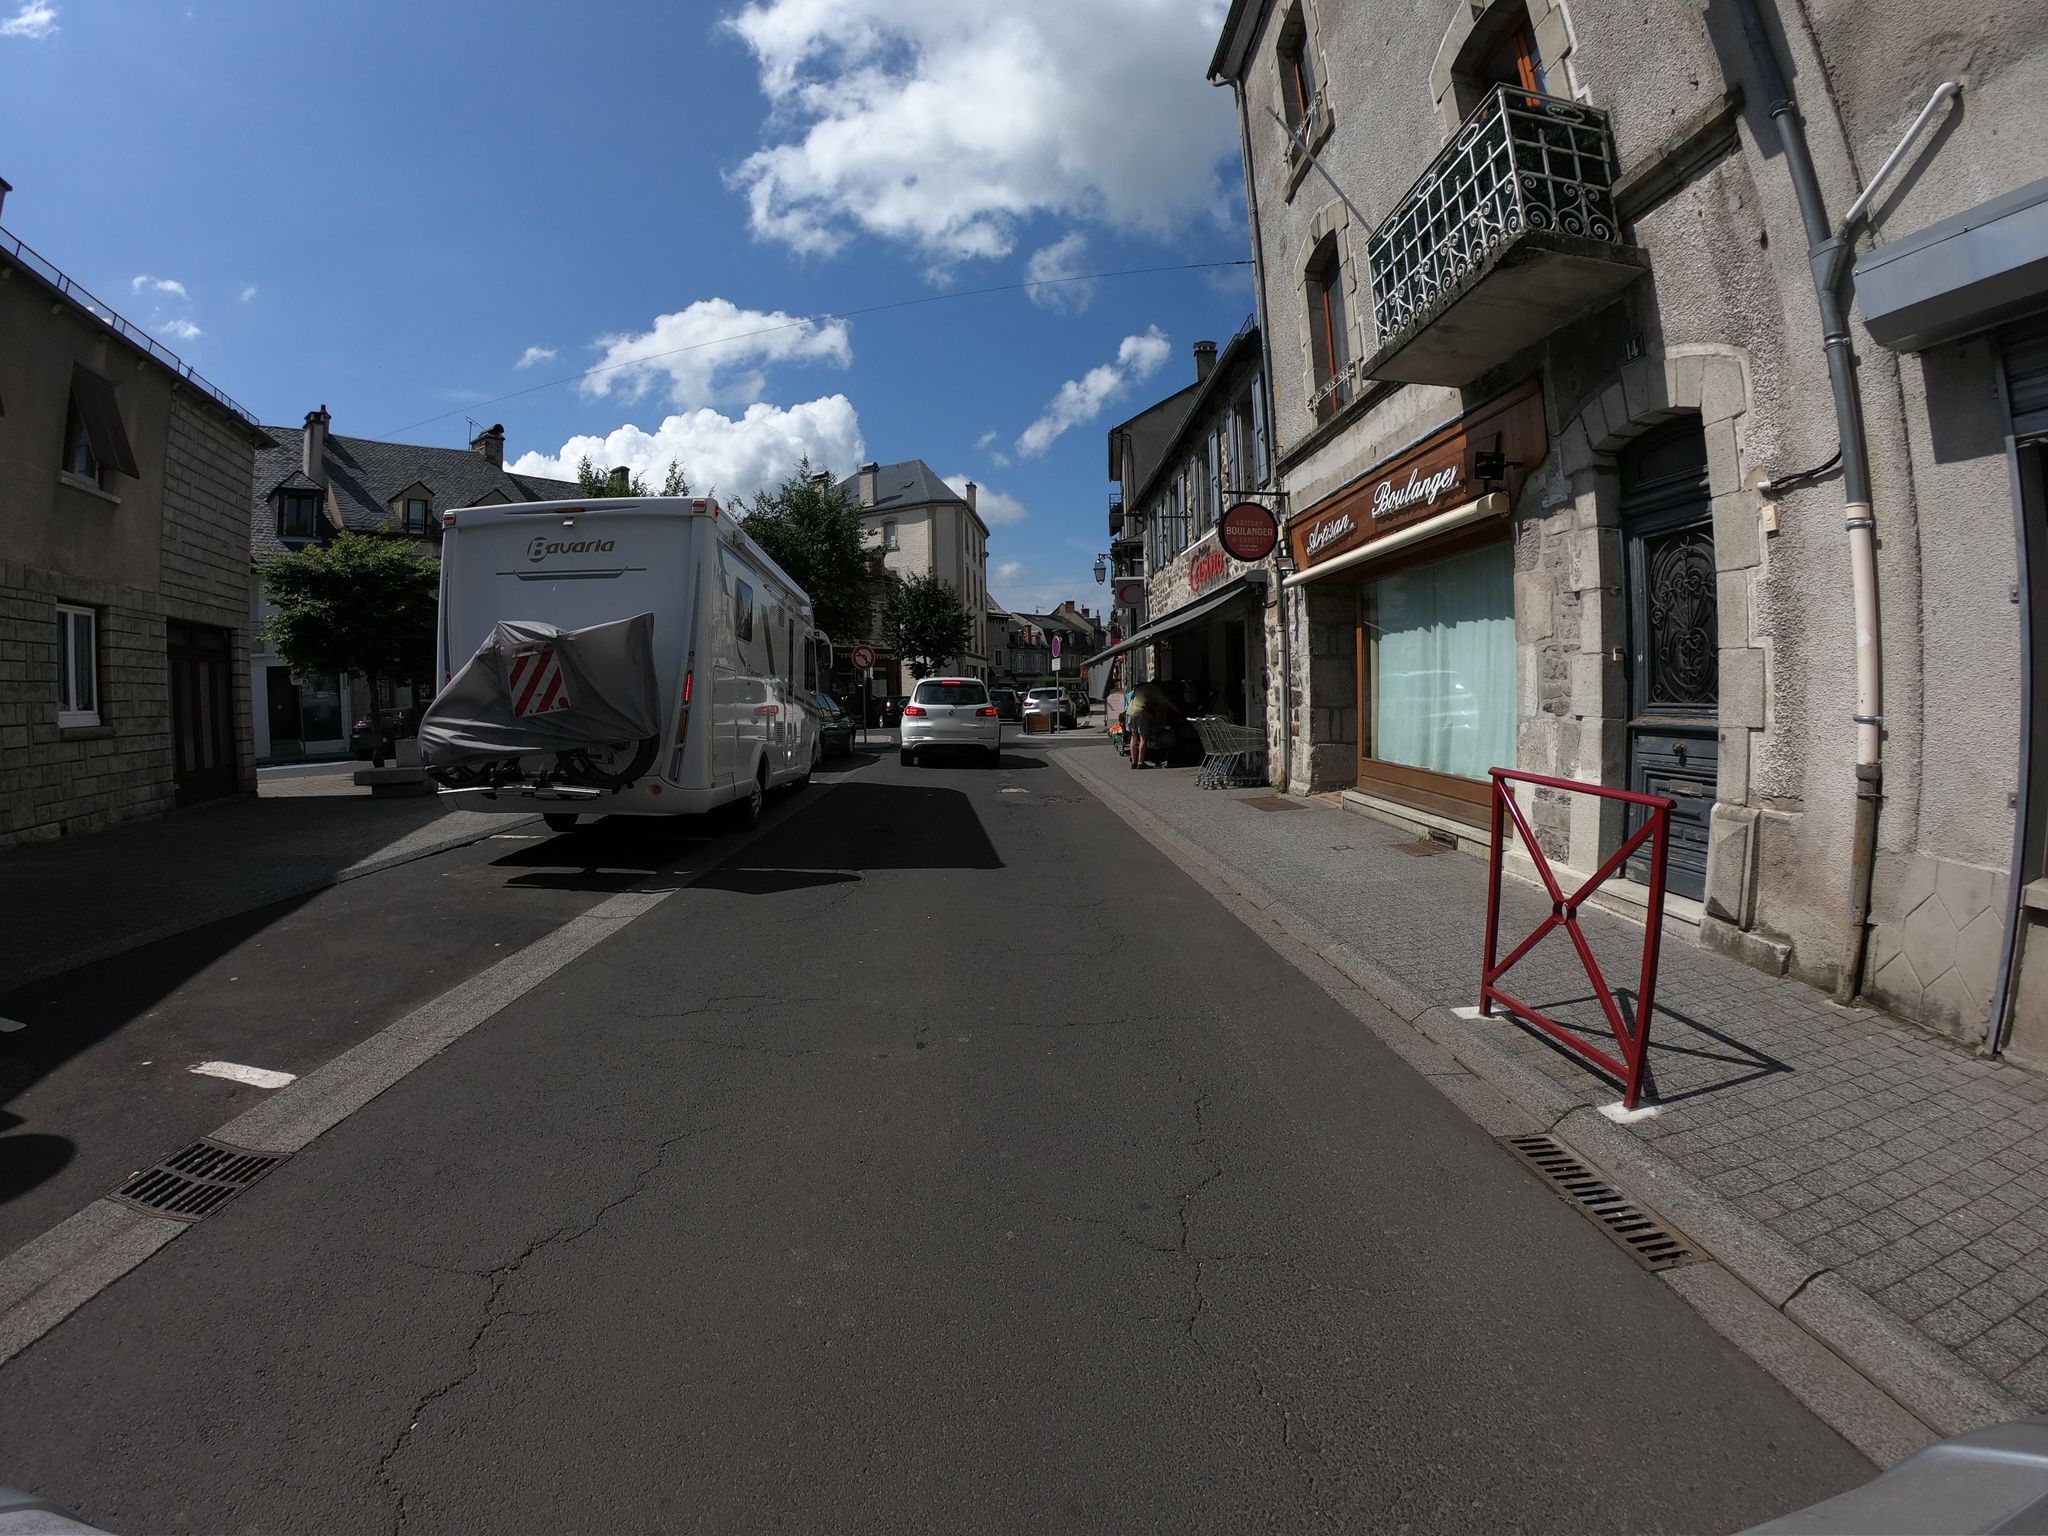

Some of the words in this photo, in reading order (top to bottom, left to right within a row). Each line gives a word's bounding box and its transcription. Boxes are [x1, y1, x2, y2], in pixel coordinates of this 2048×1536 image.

[1626, 339, 1639, 360] 14
[1306, 514, 1350, 555] Artisan
[1371, 464, 1460, 516] Boulanger
[1226, 526, 1273, 537] BOULANGER
[527, 537, 615, 563] Bavaria
